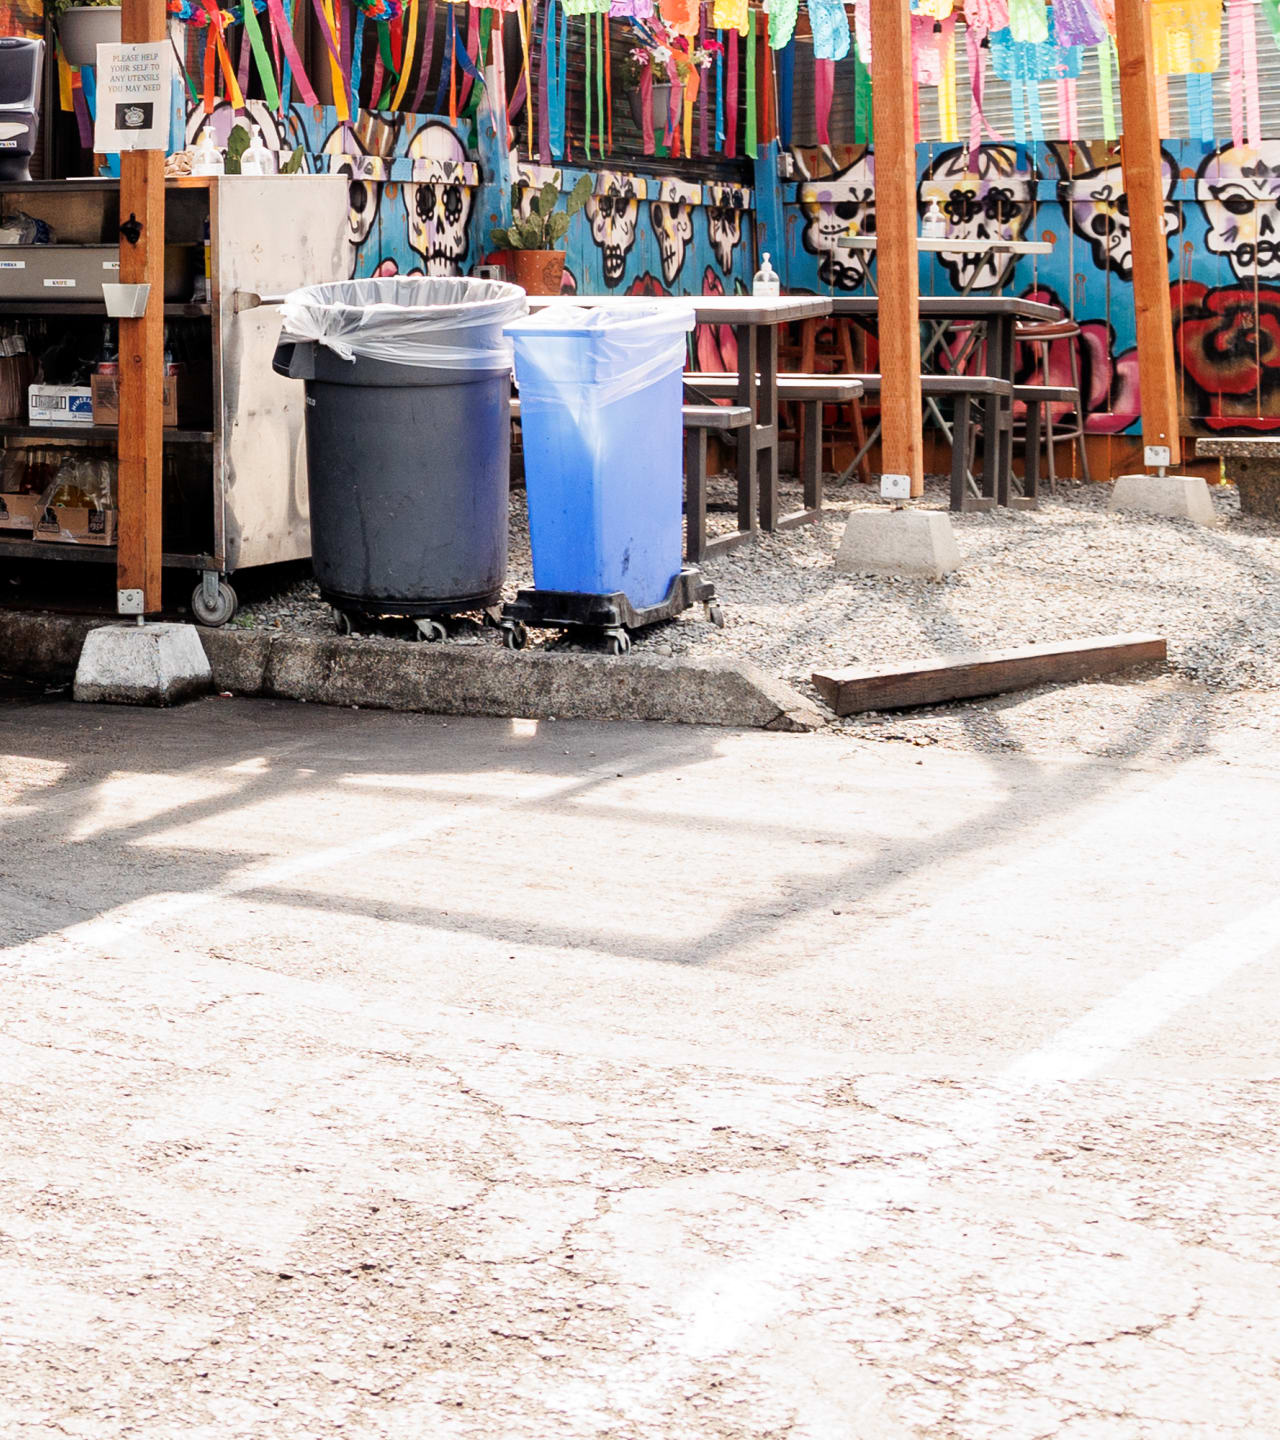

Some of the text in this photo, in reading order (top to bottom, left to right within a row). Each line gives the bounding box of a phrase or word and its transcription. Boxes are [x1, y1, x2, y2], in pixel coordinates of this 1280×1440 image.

[112, 53, 158, 62] PLEASE HELP
[132, 64, 150, 72] SELF
[151, 63, 160, 71] TO
[127, 73, 160, 82] UTENSILS
[108, 84, 161, 94] YOU MAY NEED
